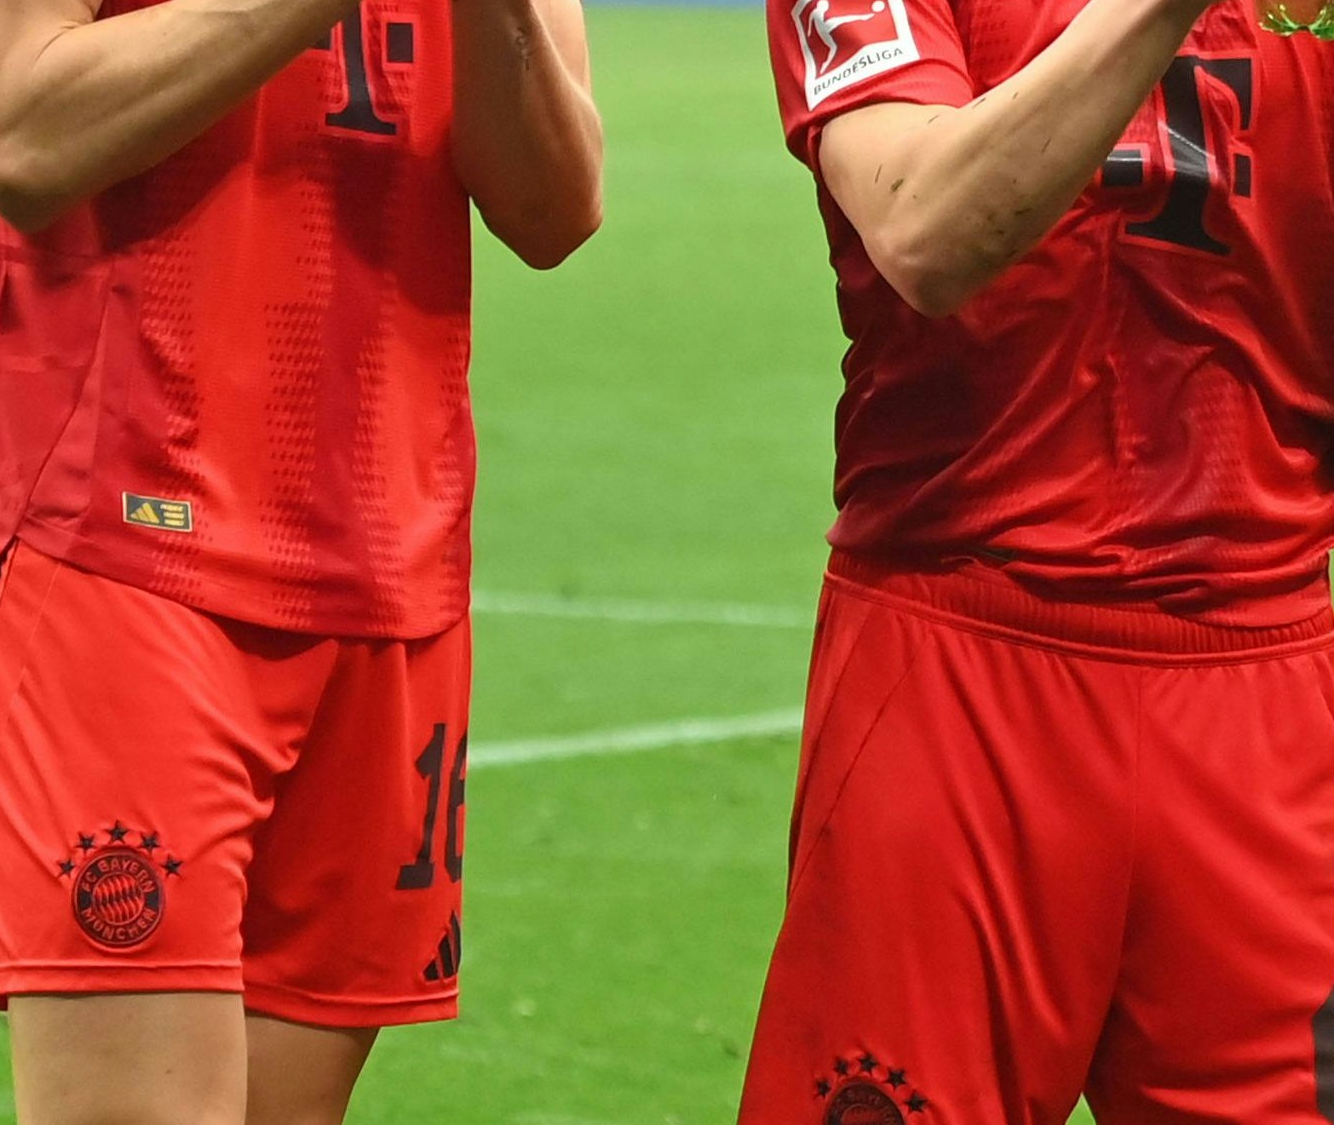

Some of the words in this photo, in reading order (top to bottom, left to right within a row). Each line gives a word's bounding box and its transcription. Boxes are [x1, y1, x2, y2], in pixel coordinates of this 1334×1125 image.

[813, 47, 903, 96] BUNDESLIGA
[81, 871, 98, 893] FC
[97, 857, 156, 893] BAYERN
